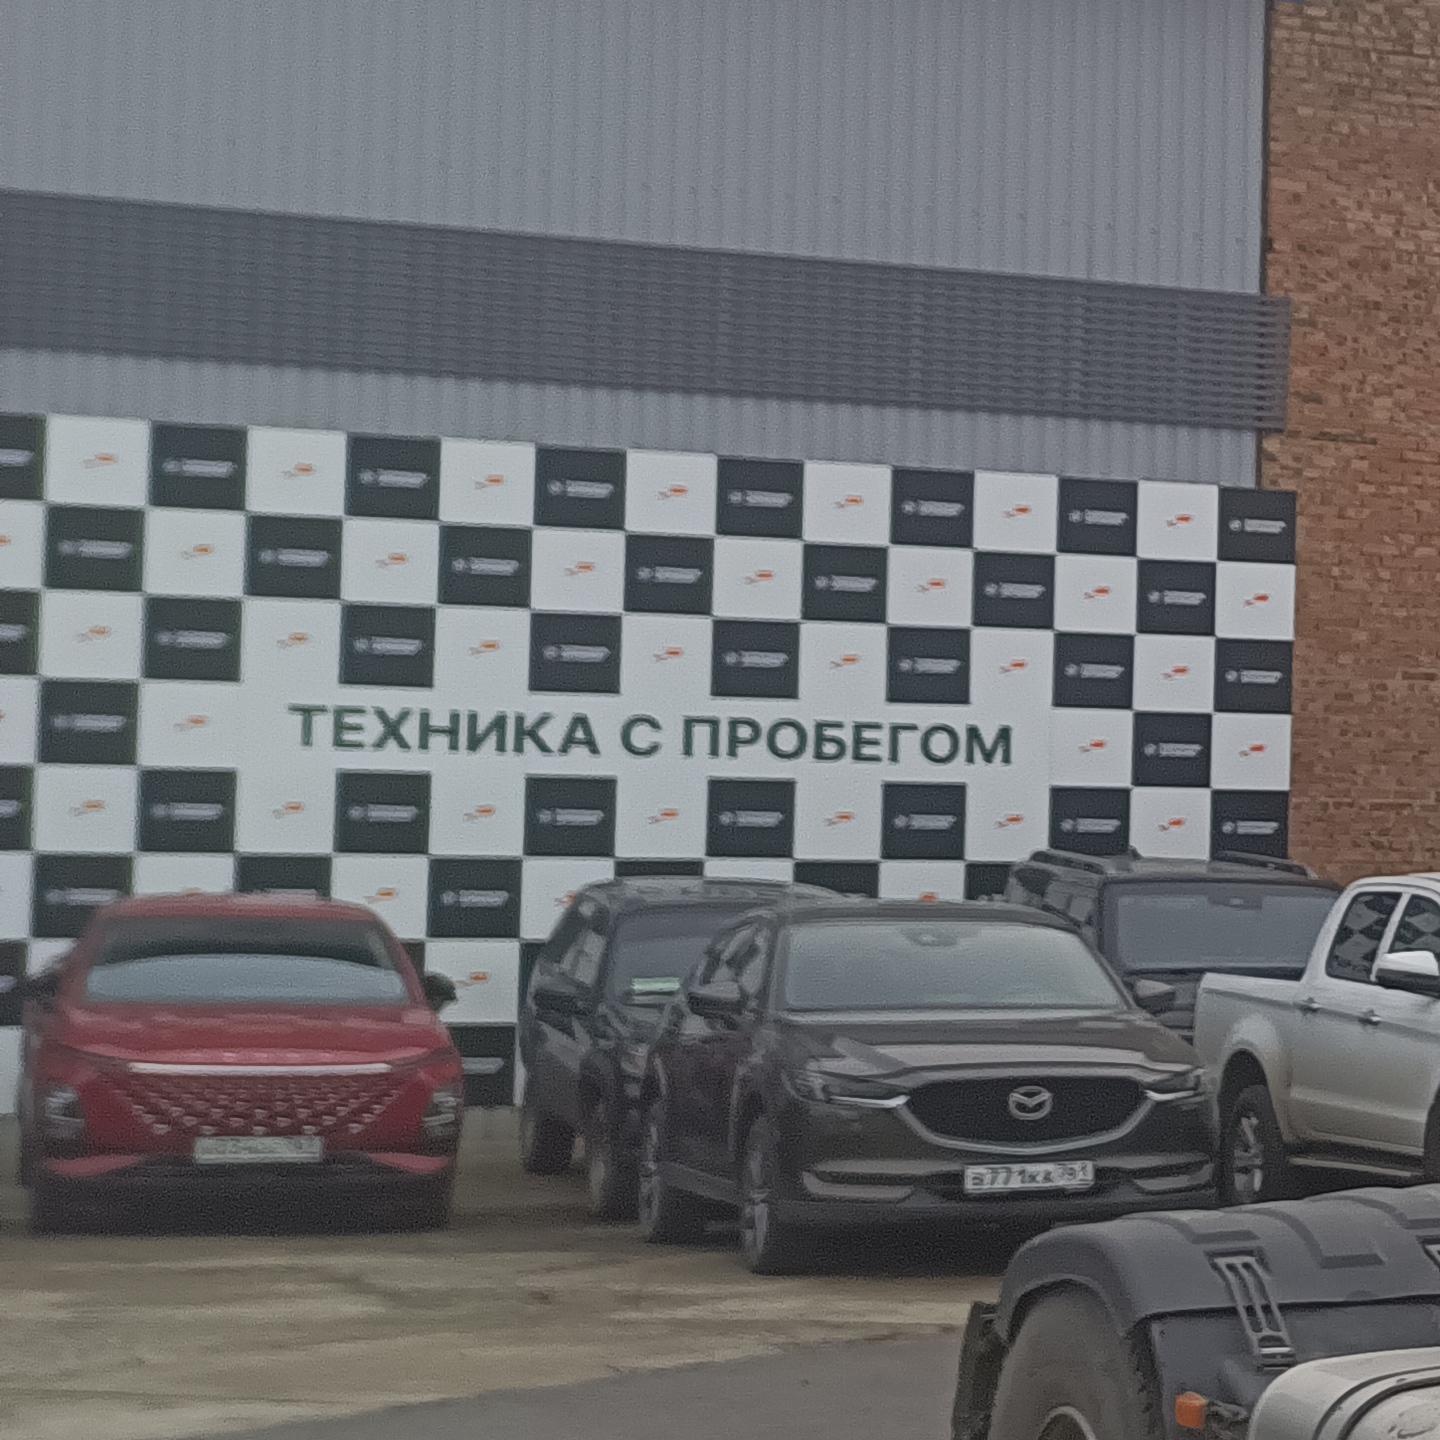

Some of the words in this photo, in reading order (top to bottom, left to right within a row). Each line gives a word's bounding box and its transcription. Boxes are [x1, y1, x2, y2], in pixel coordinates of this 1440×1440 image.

[287, 703, 601, 755] ТЕХНИКА
[620, 713, 662, 757] С
[682, 715, 1012, 766] ПРОБЕГОМ
